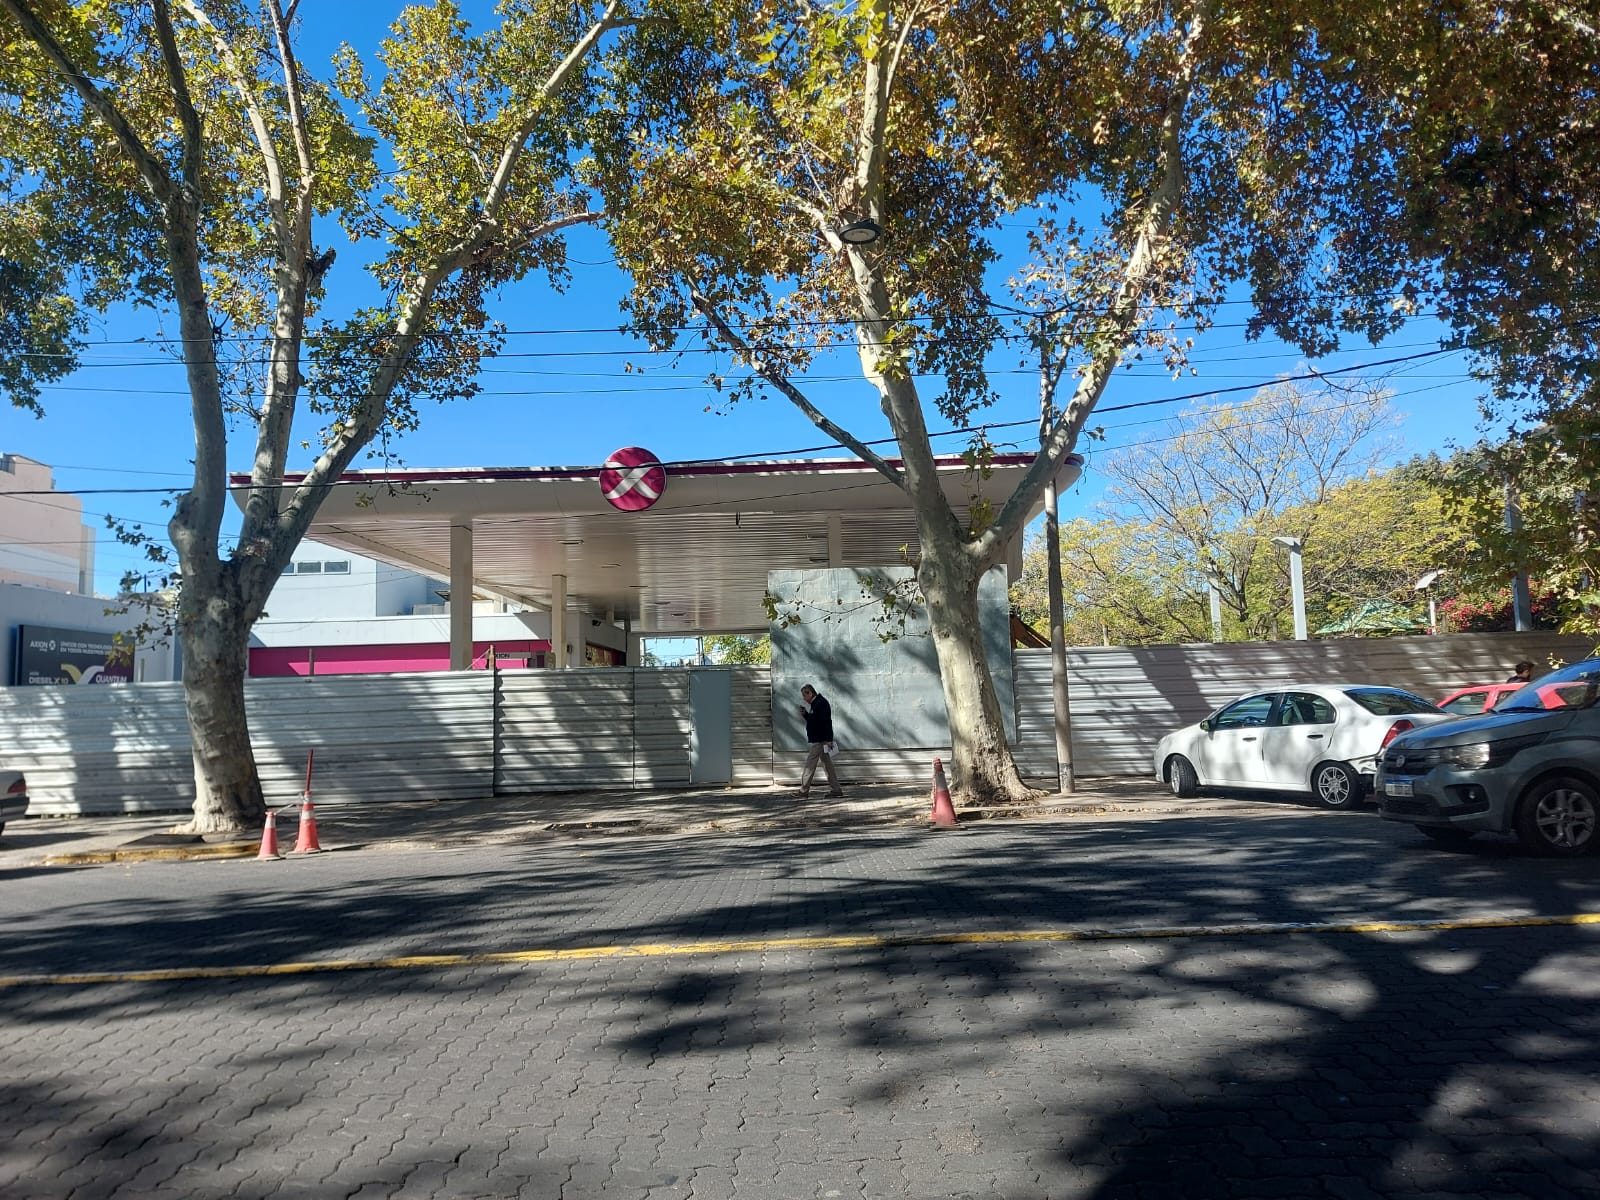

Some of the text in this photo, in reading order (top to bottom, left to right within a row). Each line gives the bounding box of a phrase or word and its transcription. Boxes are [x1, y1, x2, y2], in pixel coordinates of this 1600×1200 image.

[30, 640, 48, 649] AXION
[28, 676, 52, 684] DIESEL
[96, 674, 128, 684] QUANTUM
